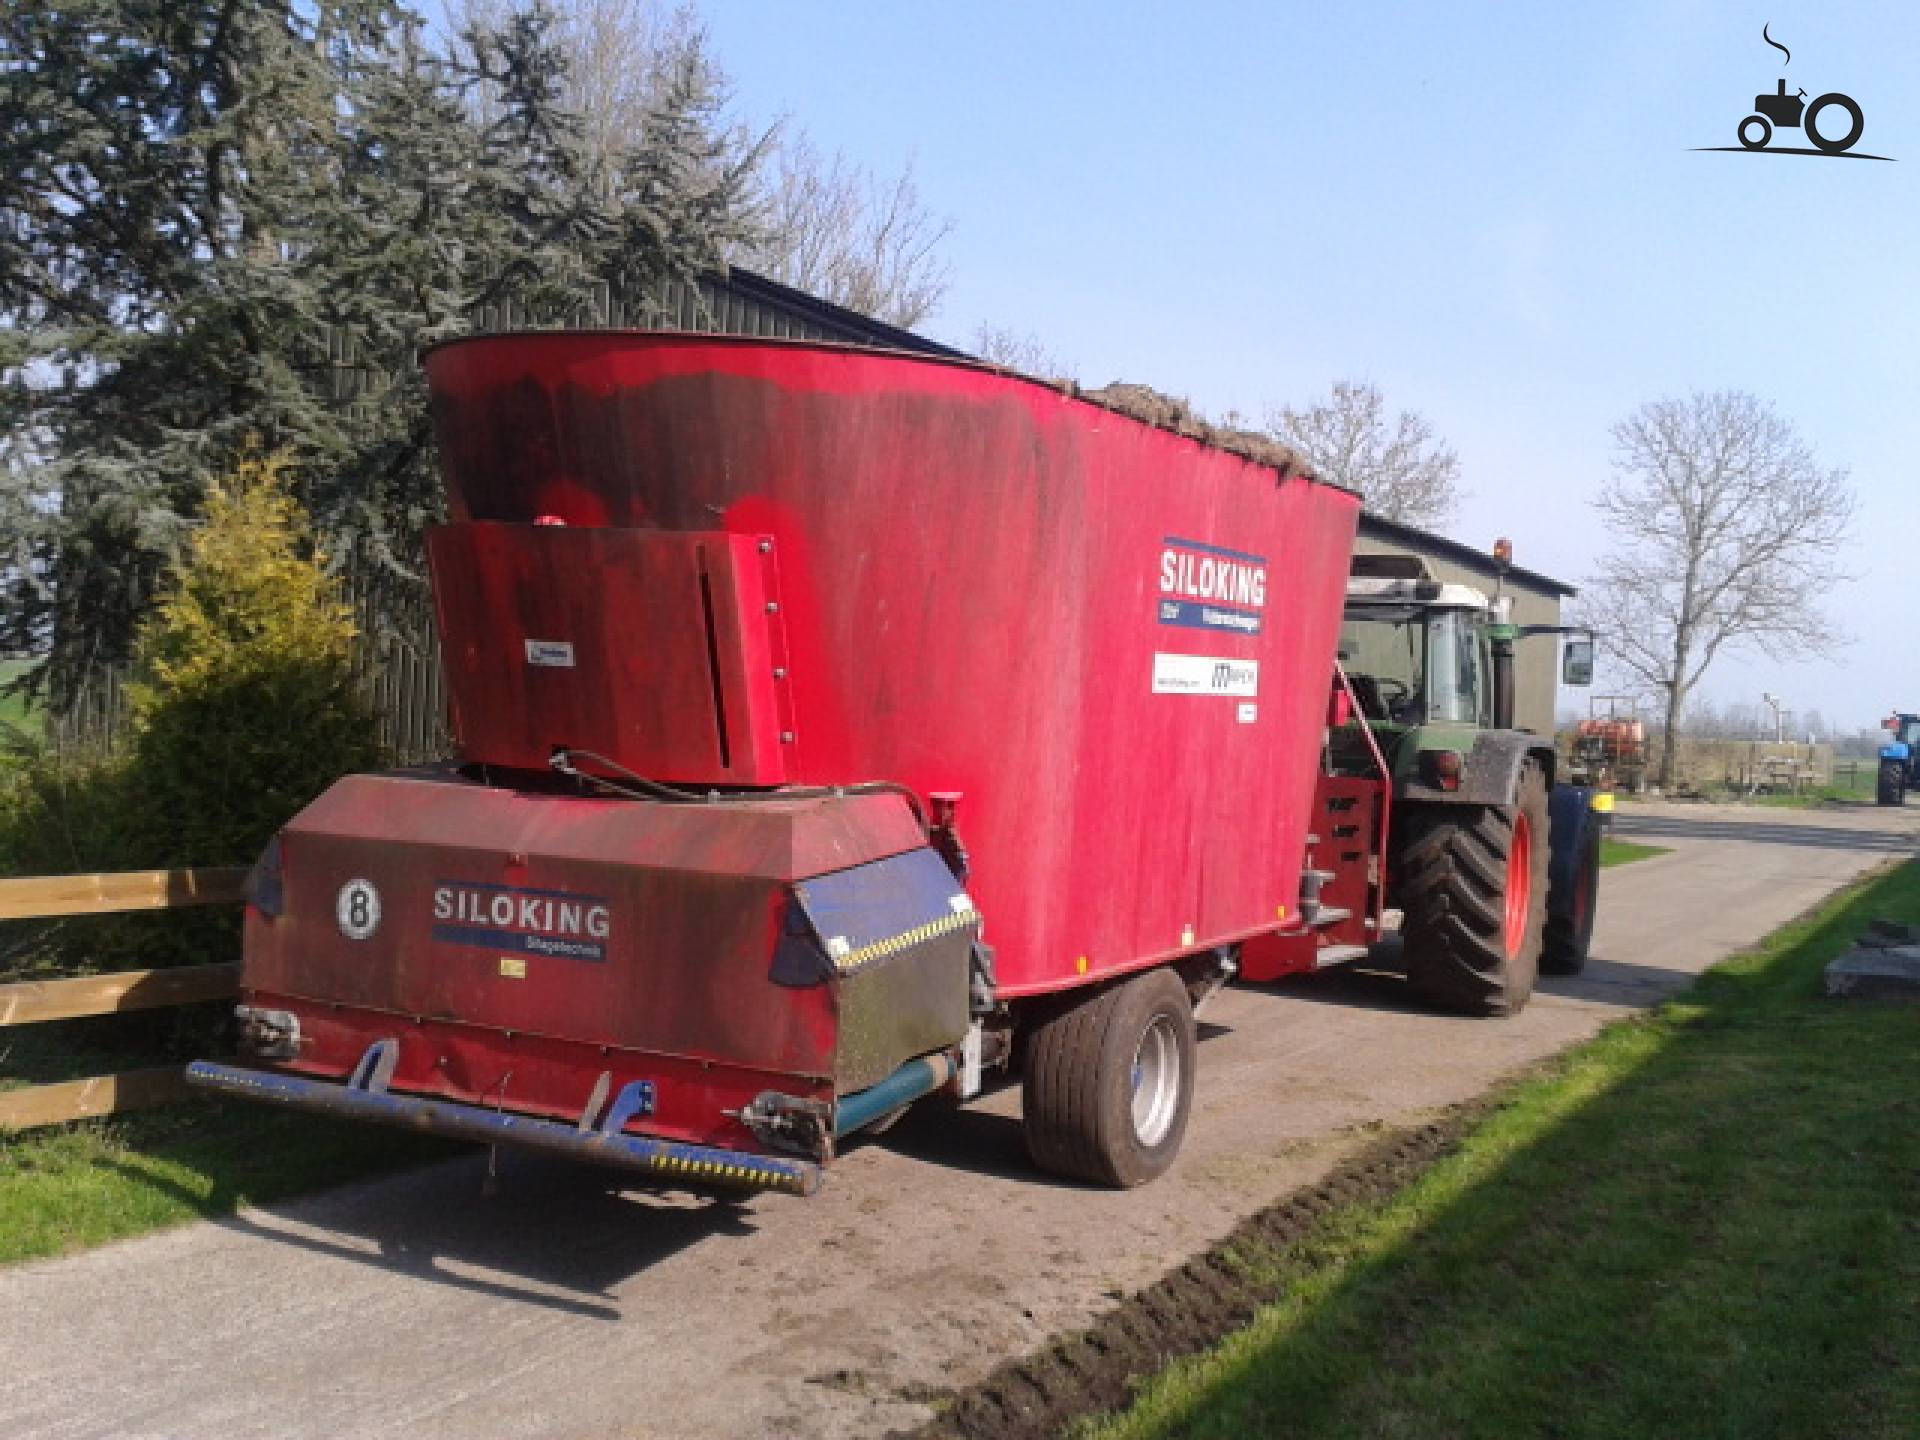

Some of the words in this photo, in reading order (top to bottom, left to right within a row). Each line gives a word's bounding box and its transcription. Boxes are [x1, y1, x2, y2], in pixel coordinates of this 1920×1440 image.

[1159, 550, 1264, 606] SILOKING
[350, 888, 369, 928] 8
[434, 887, 610, 937] SILOKING
